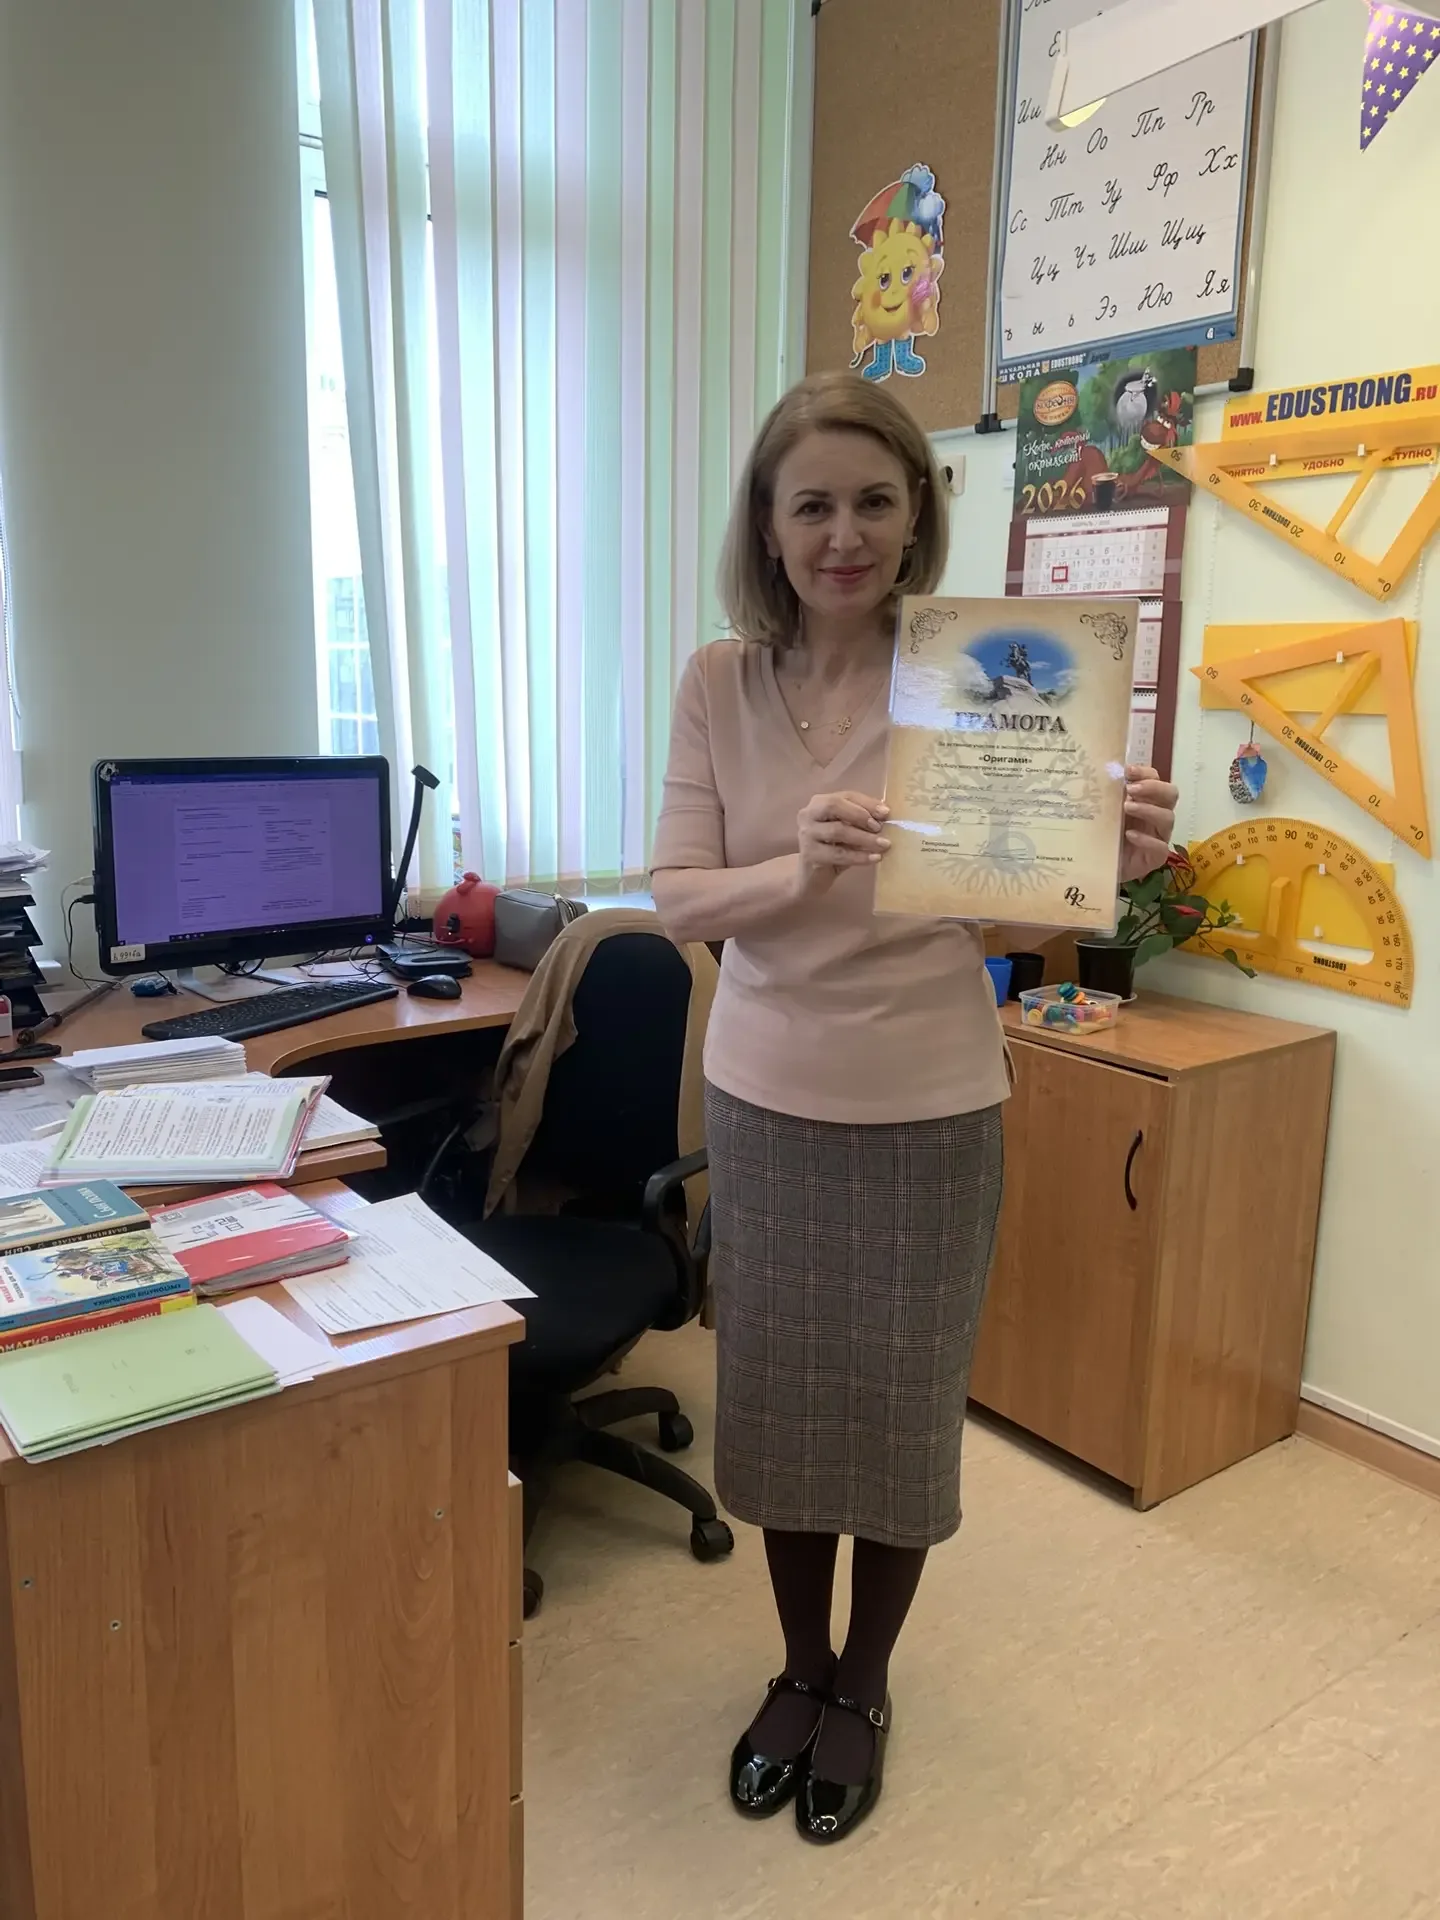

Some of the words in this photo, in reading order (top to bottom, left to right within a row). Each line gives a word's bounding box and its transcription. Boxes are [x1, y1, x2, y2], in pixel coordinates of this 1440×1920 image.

[1040, 144, 1066, 170] Нн
[1087, 128, 1108, 154] Оо
[1132, 107, 1166, 138] Пп
[1184, 92, 1216, 126] Рр
[1010, 210, 1028, 234] Сс
[1045, 192, 1084, 222] Тт
[1102, 178, 1122, 214] Уу
[1147, 162, 1178, 198] Фф
[1199, 145, 1238, 176] Хх
[1030, 255, 1060, 285] Цц
[1075, 245, 1096, 269] Чч
[1108, 231, 1148, 259] Шш
[1161, 218, 1206, 250] Щщ
[1032, 322, 1045, 335] ы
[1095, 295, 1117, 321] Ээ
[1138, 282, 1173, 311] Юю
[1196, 270, 1230, 298] Яя
[1000, 362, 1040, 374] НАЧАЛЬНАЯ
[1000, 369, 1040, 382] ШКОЛА
[1225, 467, 1265, 478] ОНЯТНО
[1302, 458, 1344, 470] УДОБНО
[1021, 477, 1086, 515] 2026
[955, 712, 1066, 733] ГРАМОТА
[979, 754, 1032, 764] «Оригами»
[1285, 829, 1297, 840] 90
[1306, 831, 1318, 840] 100
[1326, 840, 1338, 850] 110
[1344, 853, 1356, 865] 120
